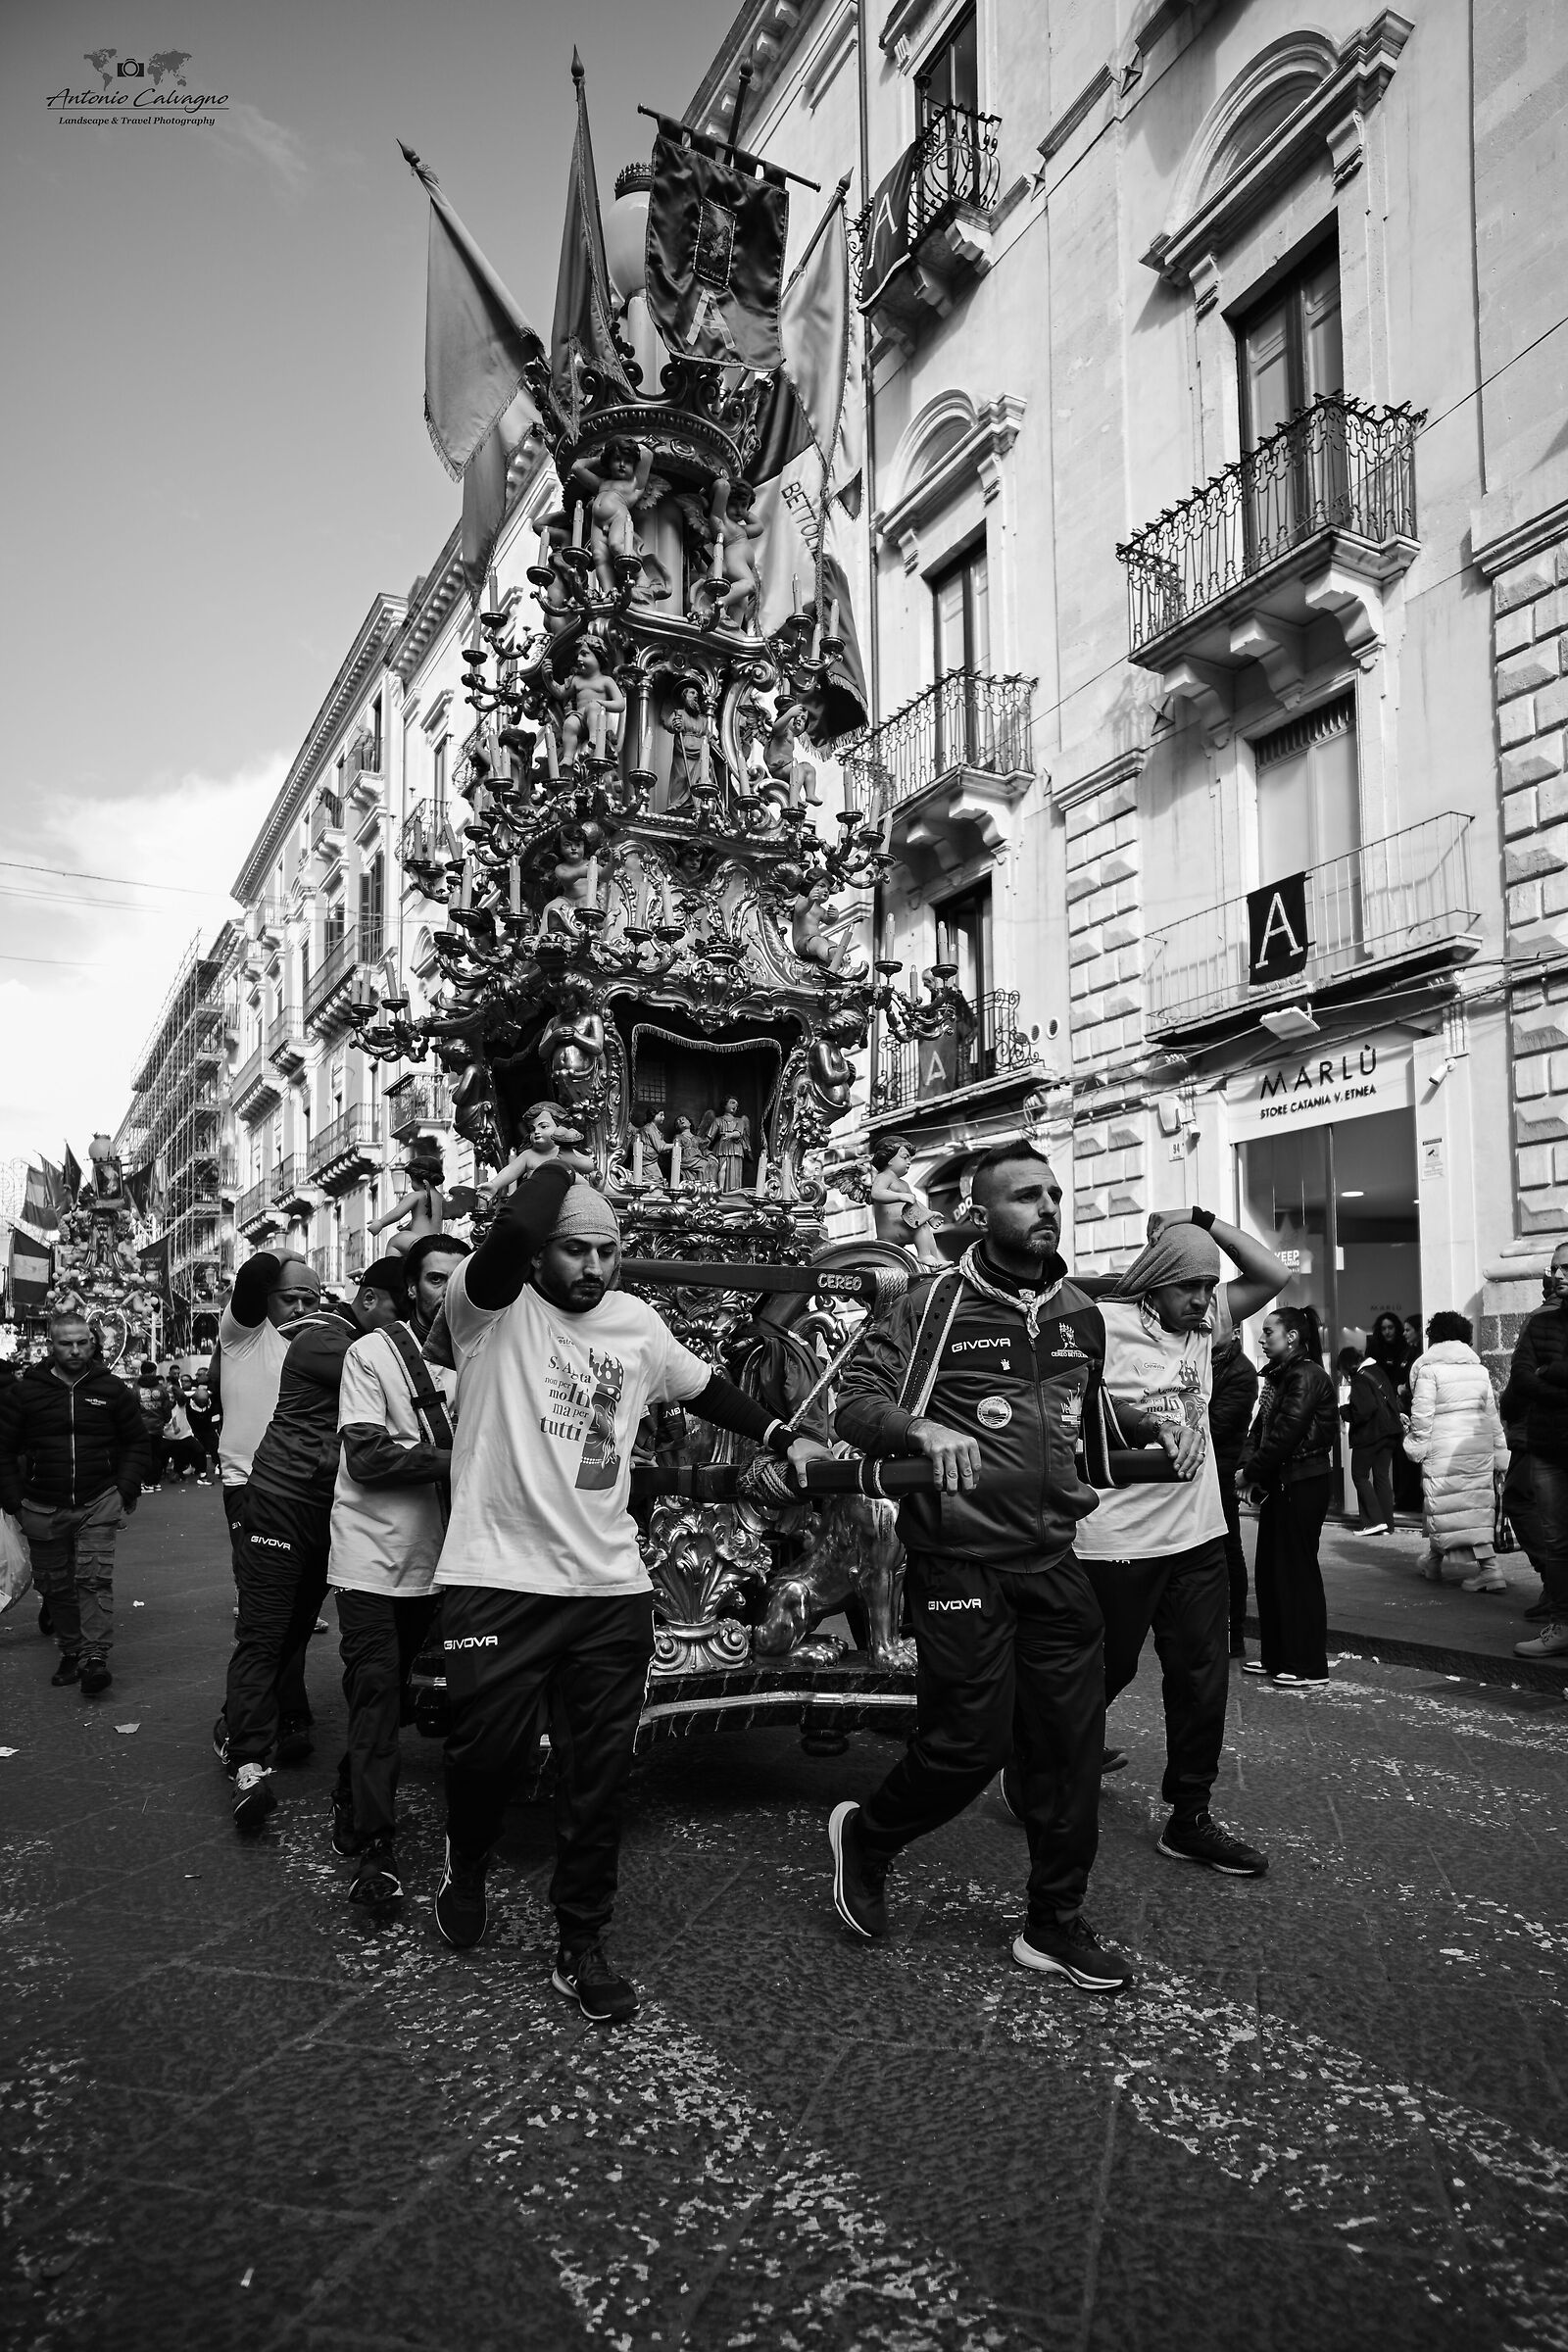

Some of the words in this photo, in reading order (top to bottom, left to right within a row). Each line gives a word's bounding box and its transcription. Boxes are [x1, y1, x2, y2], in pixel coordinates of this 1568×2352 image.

[866, 191, 899, 270] A
[686, 289, 736, 350] A
[1255, 892, 1304, 969] A
[925, 1050, 947, 1086] A
[1260, 1044, 1377, 1101] MARLÙ
[1260, 1104, 1289, 1120] STORE
[1290, 1094, 1332, 1113] CATANIA
[1345, 1084, 1377, 1101] ETNEA
[817, 1273, 862, 1292] CEREO
[952, 1338, 1011, 1352] GIVOVA
[549, 1356, 560, 1370] S.
[558, 1380, 571, 1389] per
[553, 1402, 571, 1417] ma
[572, 1408, 590, 1418] per
[540, 1415, 583, 1443] tutti
[251, 1535, 291, 1550] GIVOVA
[928, 1598, 982, 1610] GIVOVA
[444, 1636, 498, 1650] GIVOVA
